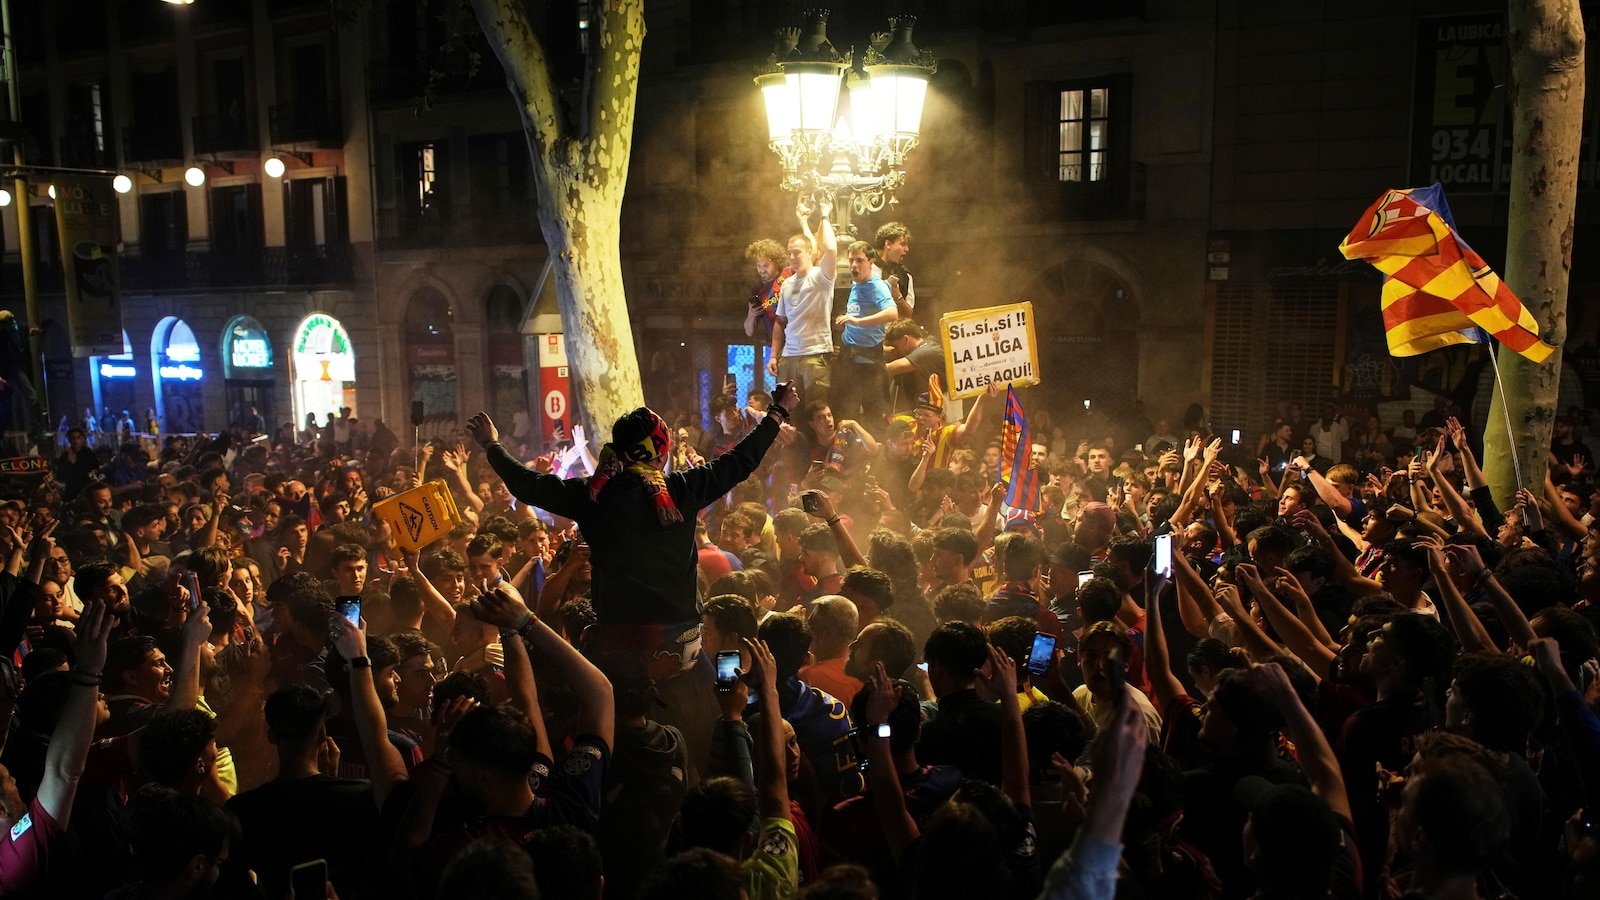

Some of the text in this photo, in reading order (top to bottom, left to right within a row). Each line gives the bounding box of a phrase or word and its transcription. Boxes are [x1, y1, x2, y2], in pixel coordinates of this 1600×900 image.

[1432, 129, 1491, 161] 934
[1430, 163, 1492, 183] LOCAL
[953, 349, 973, 364] LA
[976, 337, 1023, 360] LLIGA
[956, 377, 974, 392] JA
[993, 362, 1032, 383] AQUÍ!
[421, 496, 439, 531] CAUTION
